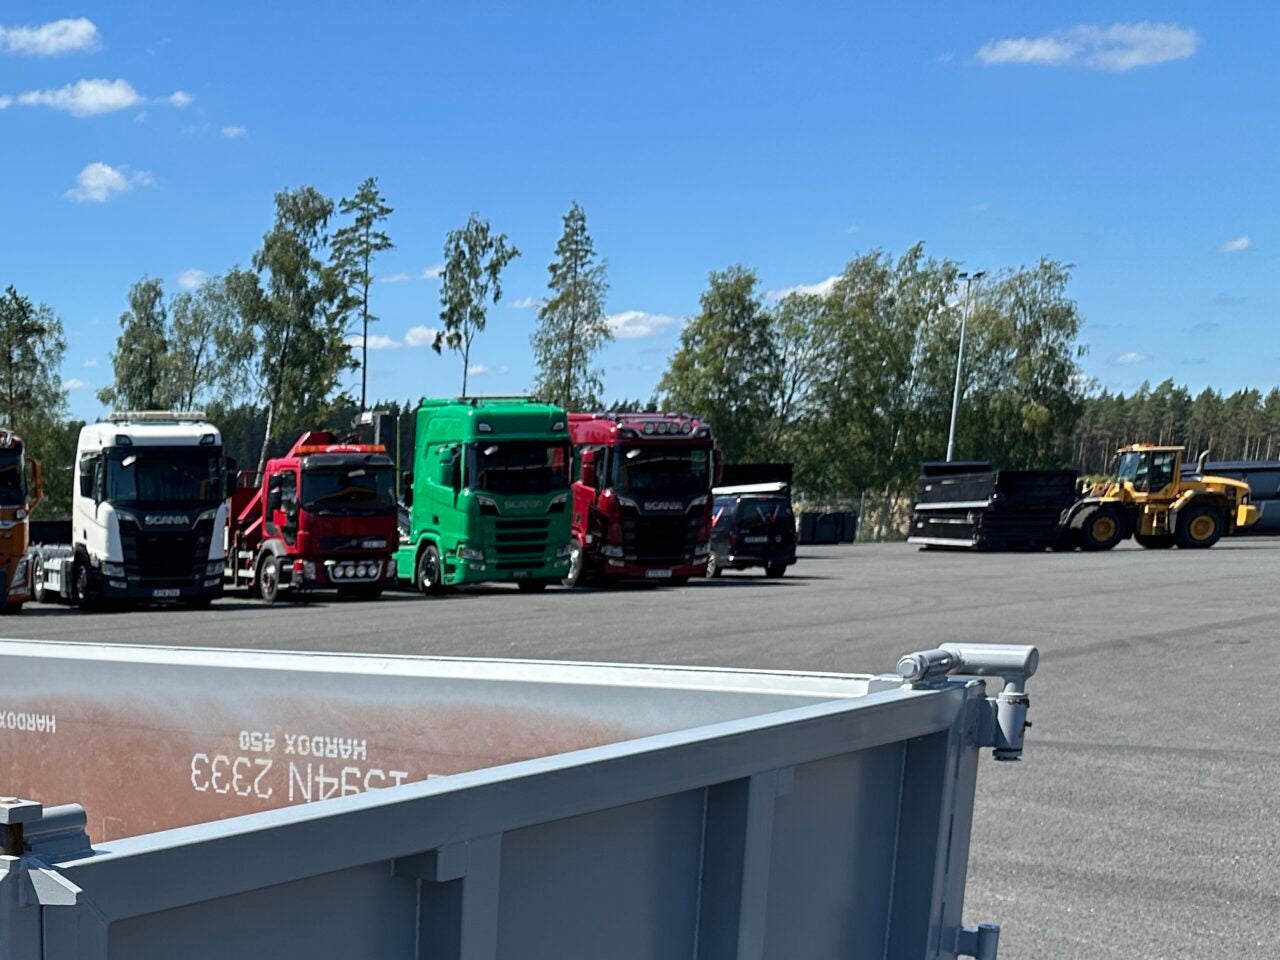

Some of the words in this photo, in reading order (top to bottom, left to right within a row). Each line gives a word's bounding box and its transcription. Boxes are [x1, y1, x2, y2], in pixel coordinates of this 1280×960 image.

[644, 501, 683, 511] SCANIA
[144, 515, 190, 525] SCANIA
[238, 730, 276, 752] 450
[284, 733, 368, 760] HARDOX
[190, 753, 273, 799] 2333
